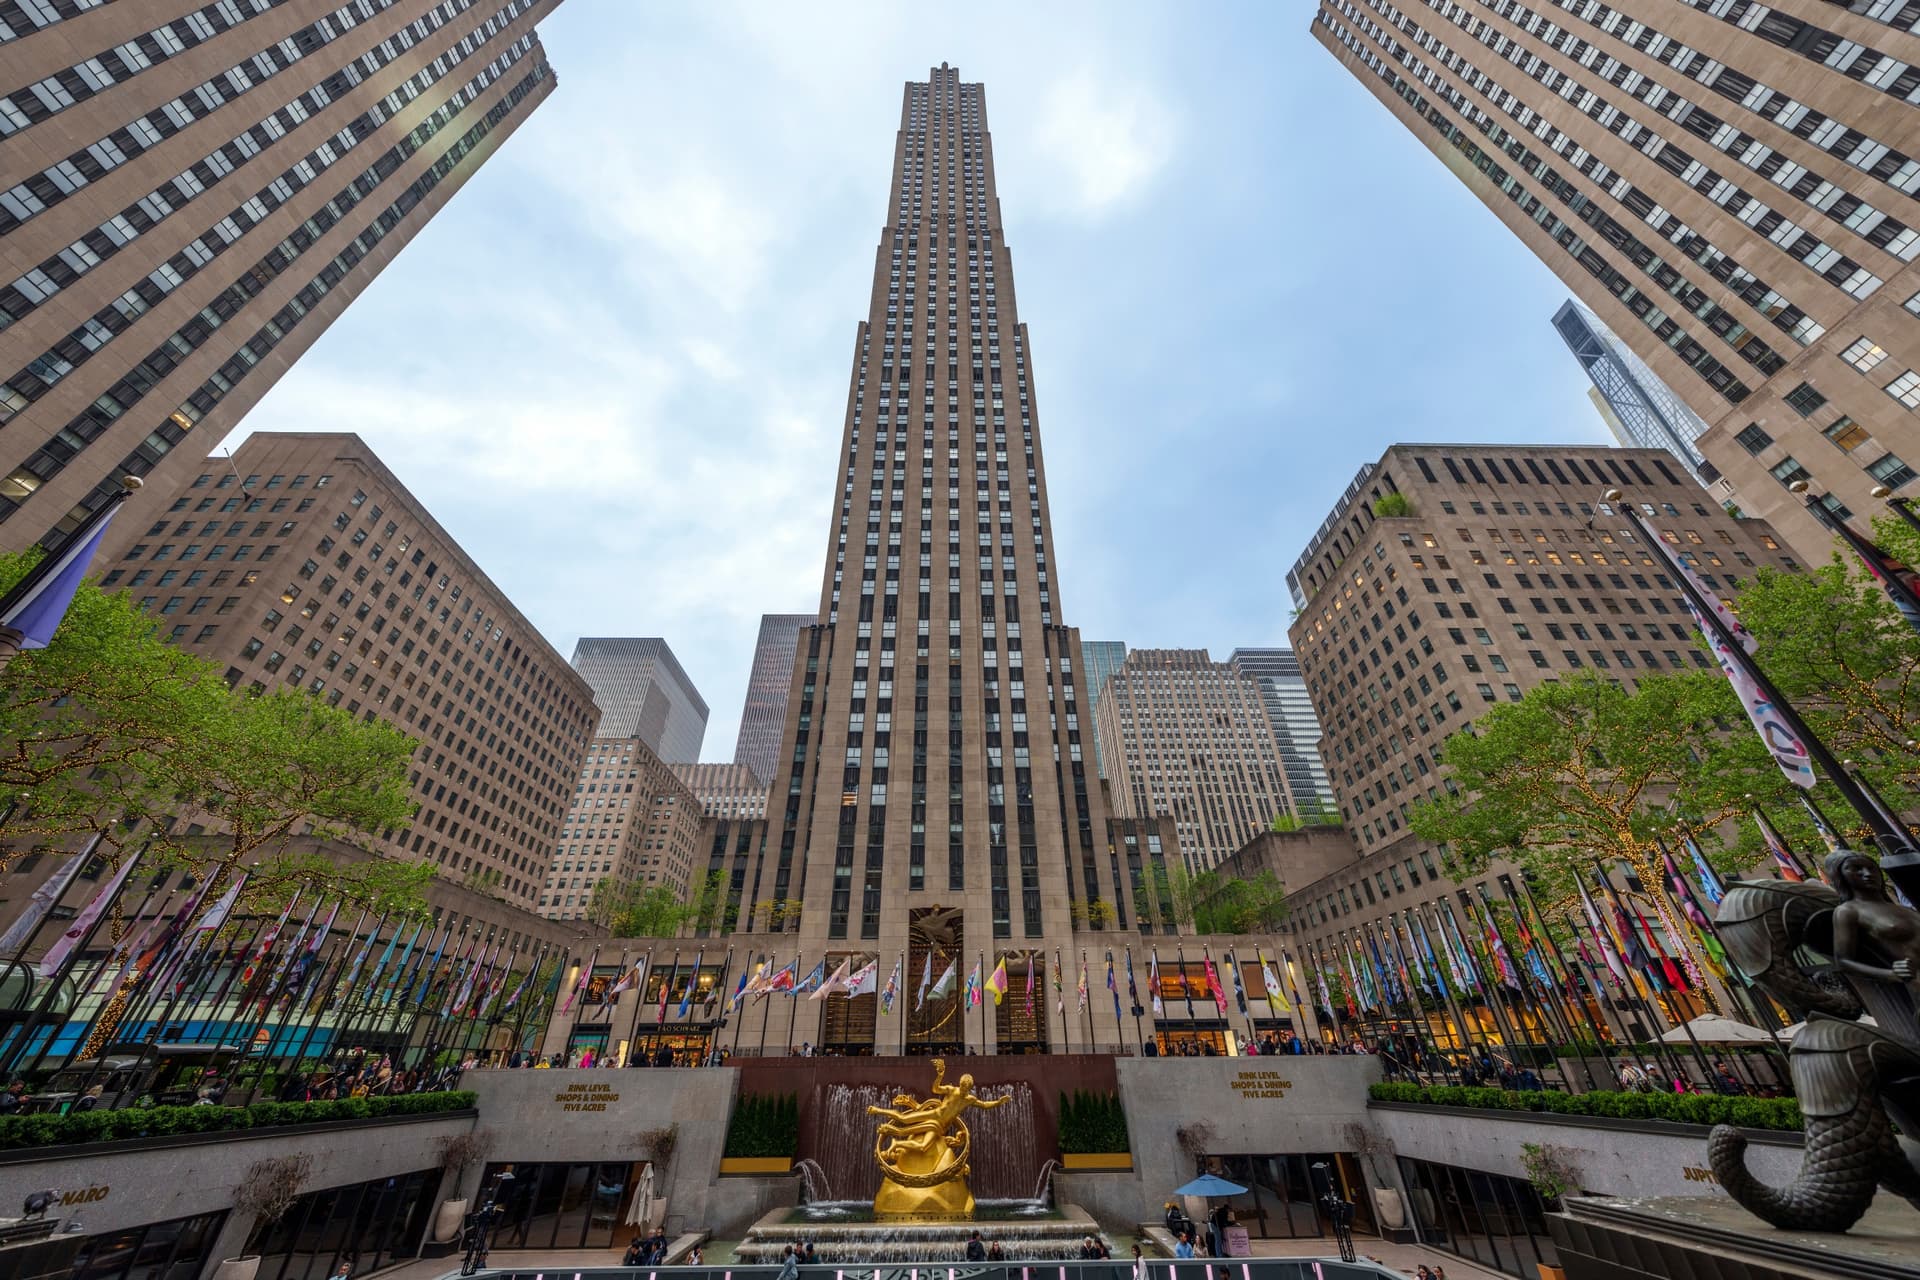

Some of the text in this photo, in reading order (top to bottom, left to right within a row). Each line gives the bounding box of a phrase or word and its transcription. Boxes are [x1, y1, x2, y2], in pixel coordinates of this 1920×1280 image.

[673, 1025, 701, 1033] SCHWARZ
[1238, 1072, 1280, 1080] RINK LEVEL
[568, 1084, 610, 1092] RINK LEVEL
[1231, 1081, 1256, 1089] SHOPS
[1264, 1081, 1292, 1089] DINING
[555, 1094, 582, 1102] SHOPS
[590, 1094, 619, 1102] DINING
[1243, 1090, 1284, 1098] FIVE ACRES
[563, 1103, 607, 1112] FIVE ACRES
[58, 1185, 110, 1207] NARO
